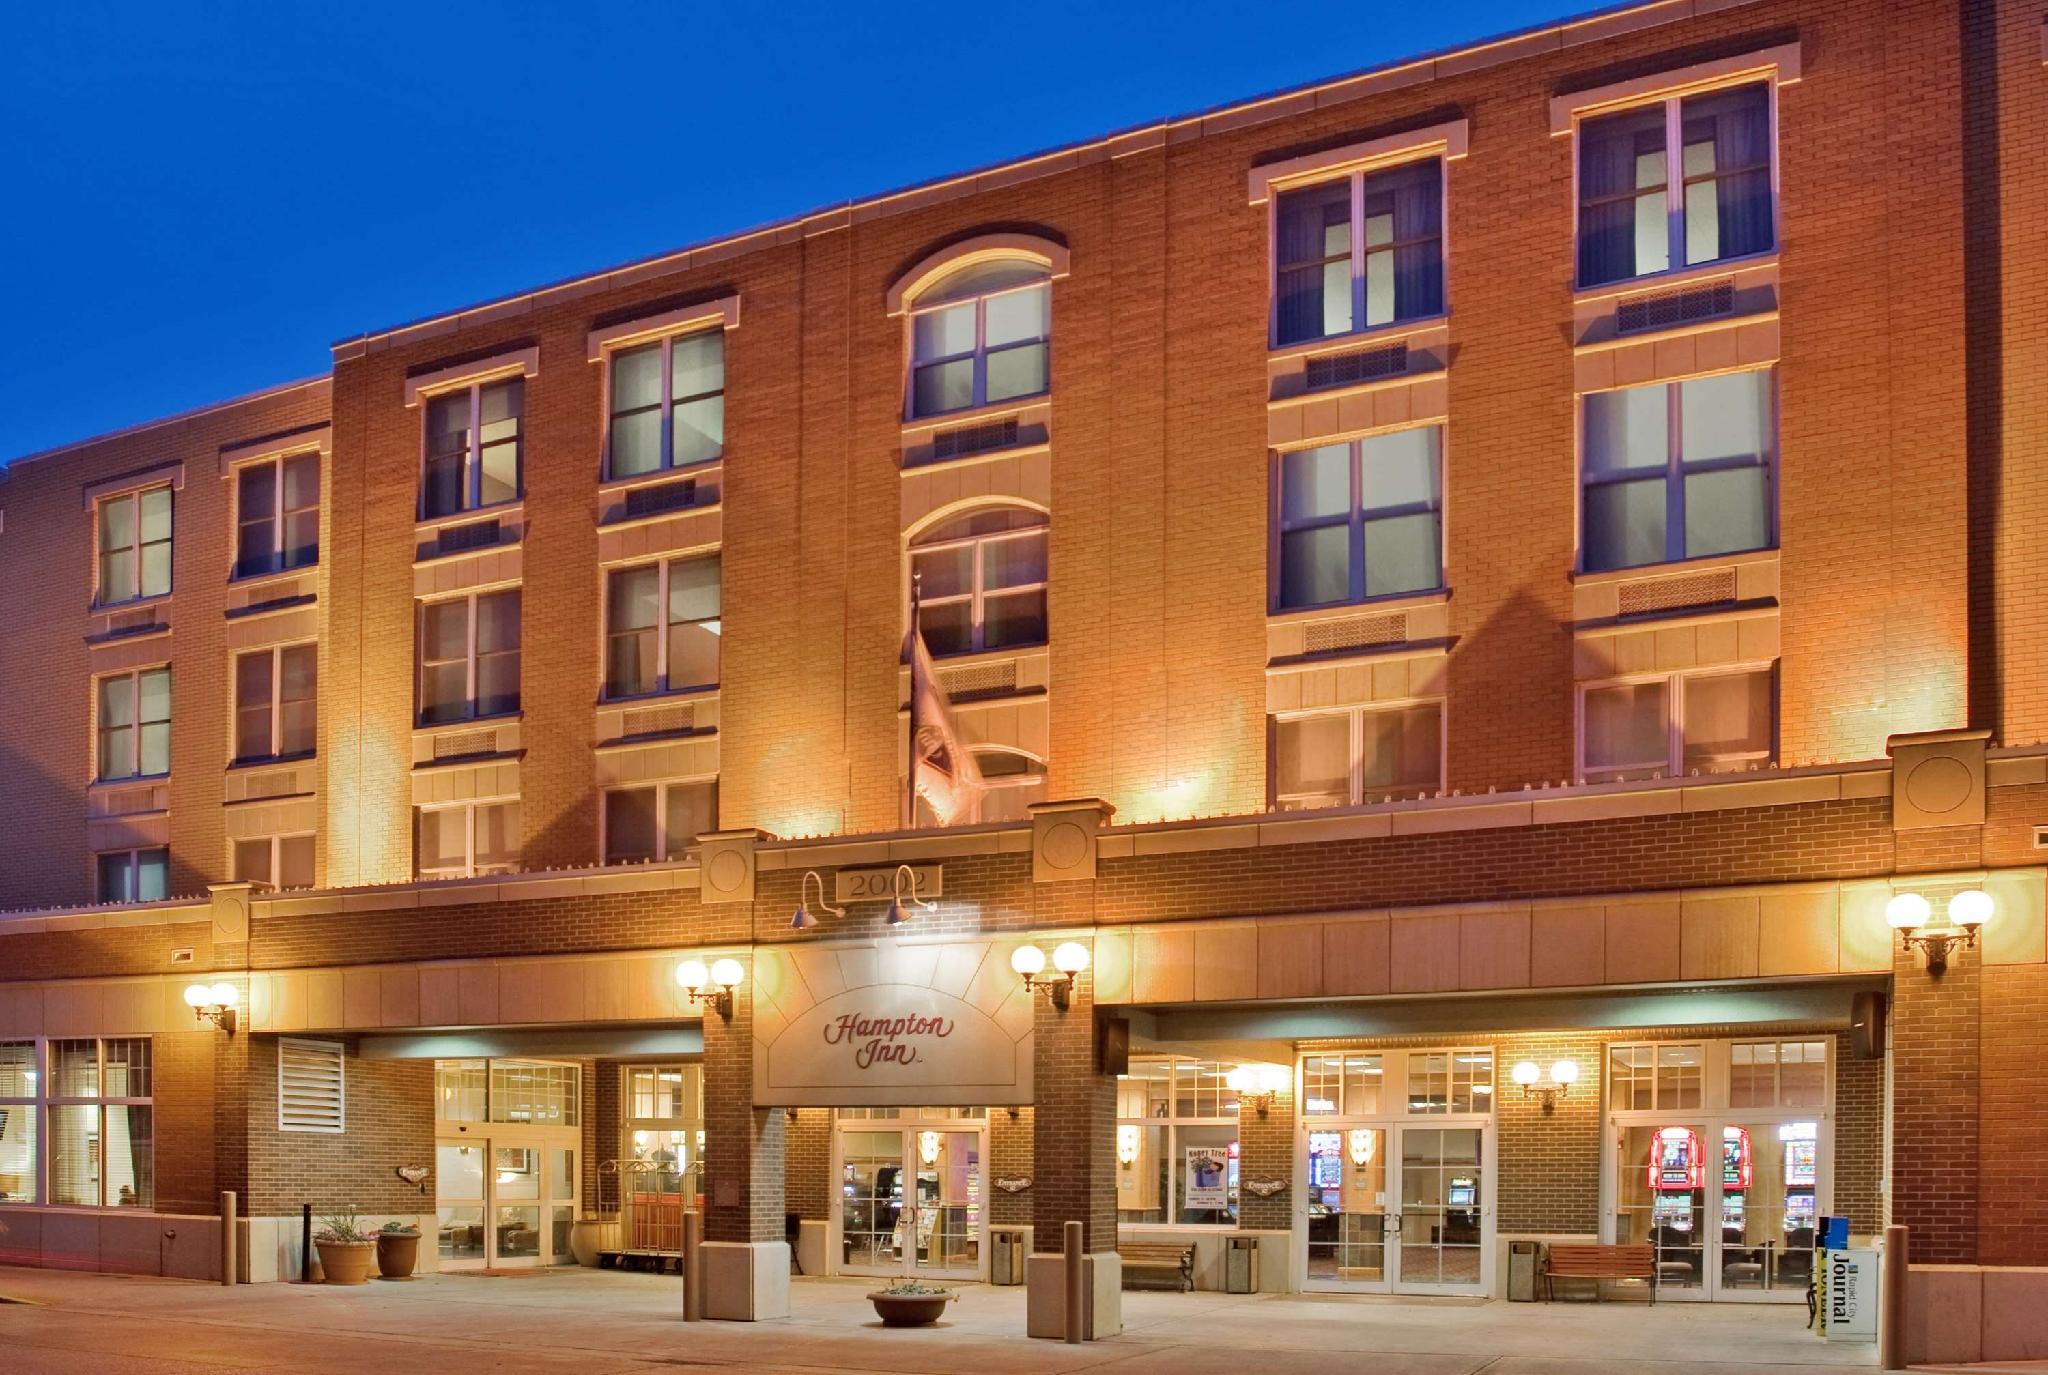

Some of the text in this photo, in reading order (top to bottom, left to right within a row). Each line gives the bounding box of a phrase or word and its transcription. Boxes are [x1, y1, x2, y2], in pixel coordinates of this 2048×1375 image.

[849, 872, 925, 896] 2002
[823, 1012, 954, 1044] Hampton
[855, 1038, 917, 1069] Inn
[1833, 1253, 1850, 1324] Journal
[1847, 1276, 1858, 1319] Rapid City
